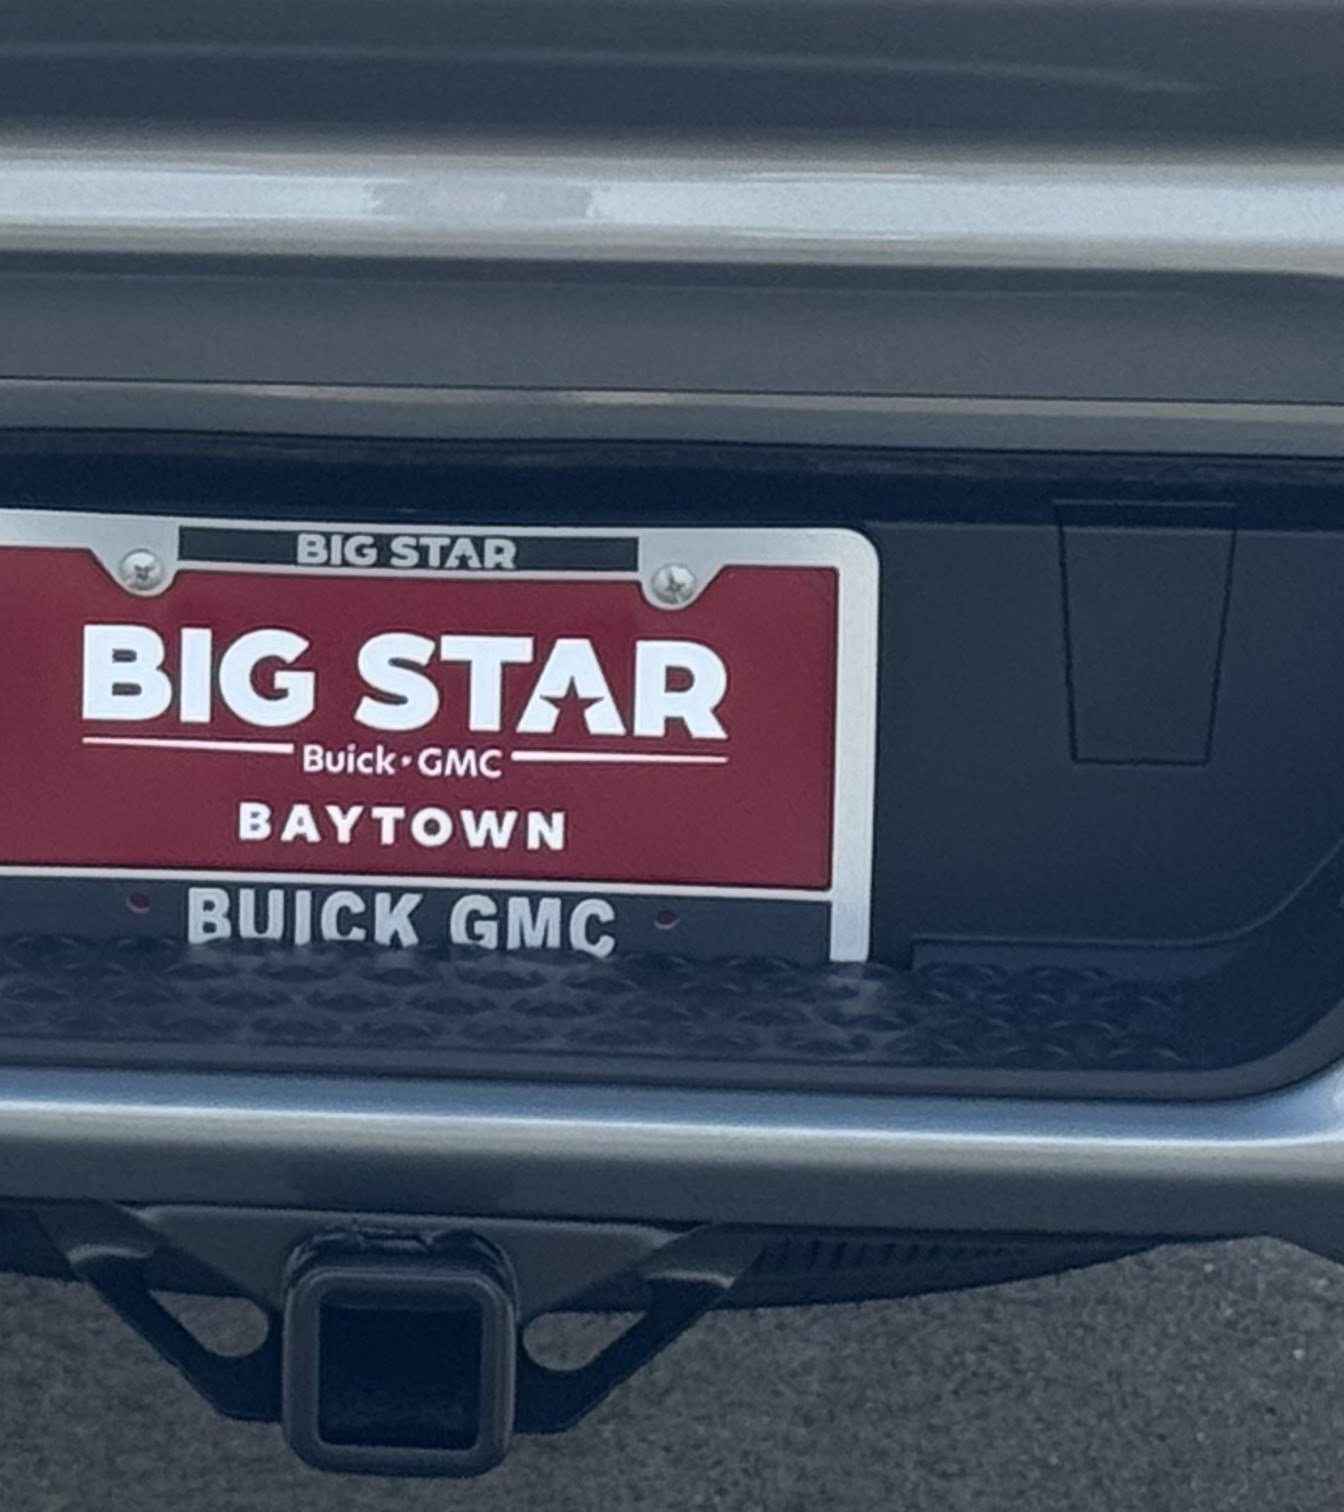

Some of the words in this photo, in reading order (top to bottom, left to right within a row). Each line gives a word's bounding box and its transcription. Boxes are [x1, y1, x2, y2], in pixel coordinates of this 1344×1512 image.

[297, 532, 378, 569] BIG
[391, 537, 516, 571] STAR
[82, 624, 315, 727] BIG
[355, 632, 728, 739] STAR
[303, 744, 395, 777] Buick
[418, 750, 502, 778] GMC
[239, 802, 564, 850] BAYTOWN
[188, 888, 421, 947] BUICK
[451, 895, 616, 957] GMC
